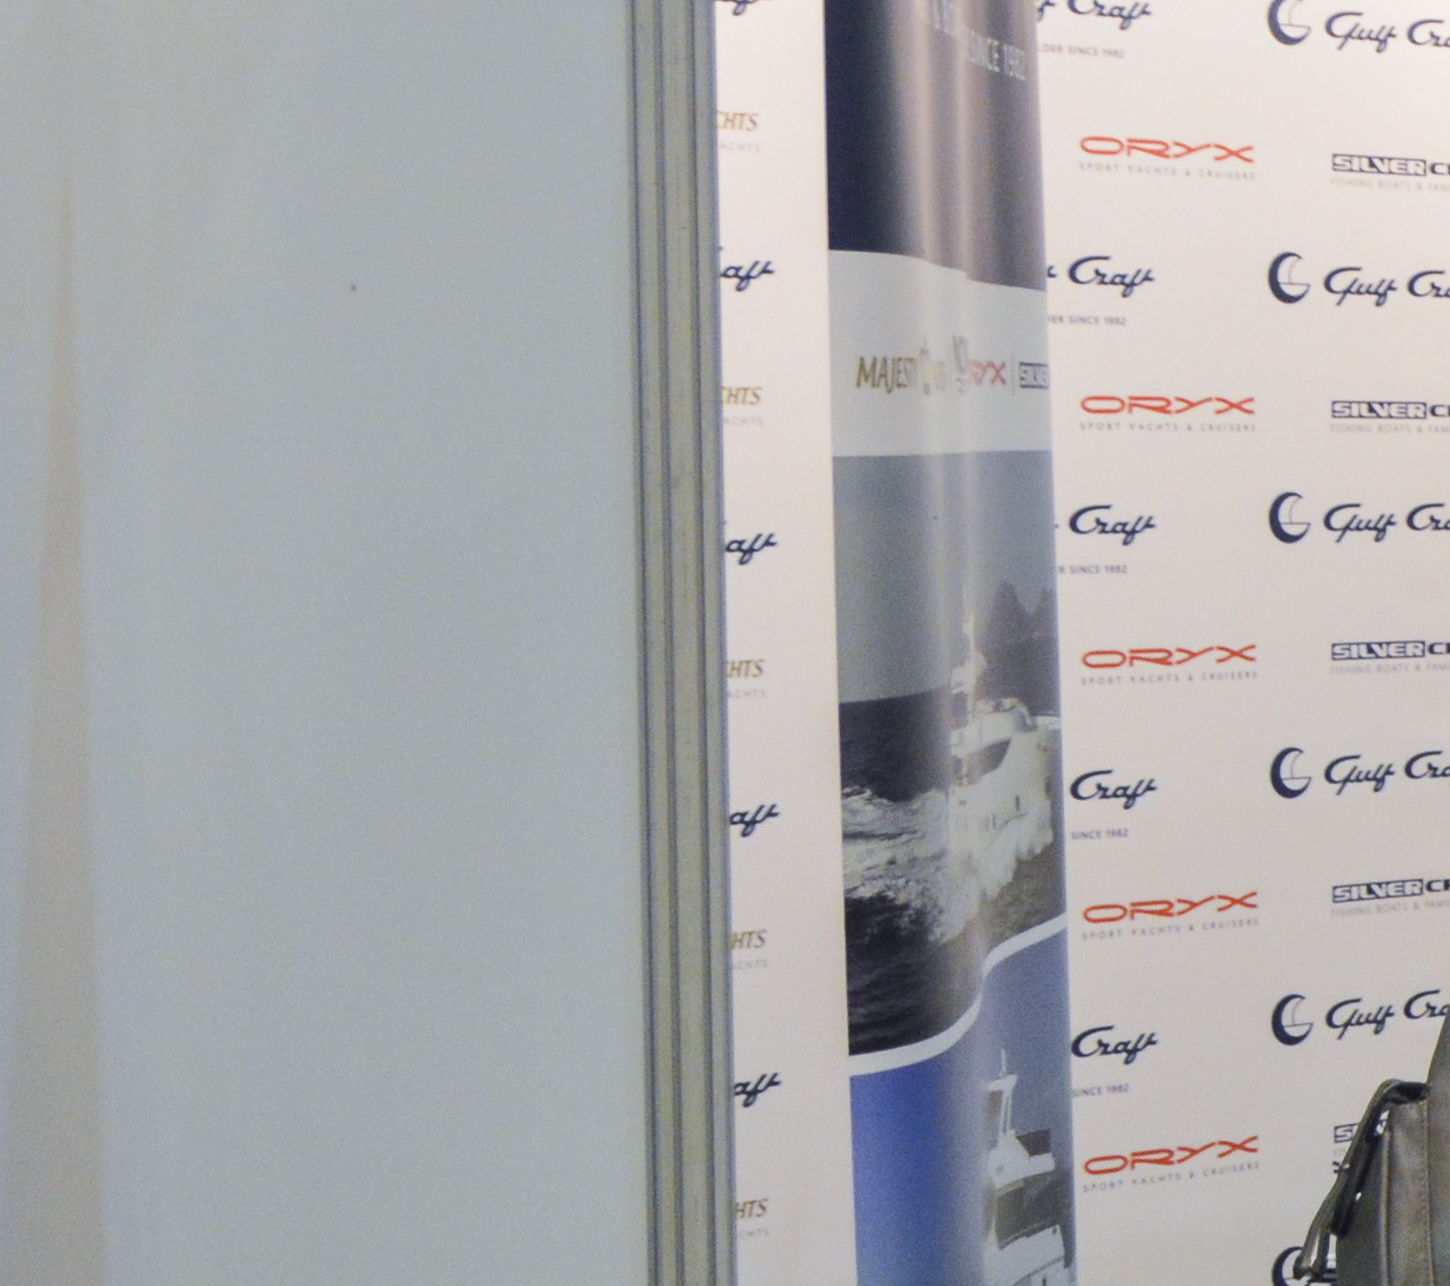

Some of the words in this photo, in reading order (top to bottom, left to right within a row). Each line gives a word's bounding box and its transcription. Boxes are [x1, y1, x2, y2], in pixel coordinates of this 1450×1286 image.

[1324, 10, 1398, 53] Gulf
[1080, 135, 1255, 163] ORYX
[1068, 255, 1154, 298] Craft
[1322, 266, 1398, 306] Gulf
[1081, 395, 1256, 415] ORYX
[1068, 504, 1157, 547] Craft
[1323, 503, 1397, 543] Gulf
[1082, 644, 1257, 668] ORYX
[1069, 769, 1158, 810] Craft
[1323, 755, 1396, 795] Gulf
[1083, 890, 1258, 923] ORYX
[1324, 998, 1395, 1040] Gulf
[1403, 989, 1450, 1019] Cra
[1070, 1025, 1158, 1065] Craft
[1084, 1134, 1259, 1175] ORYX
